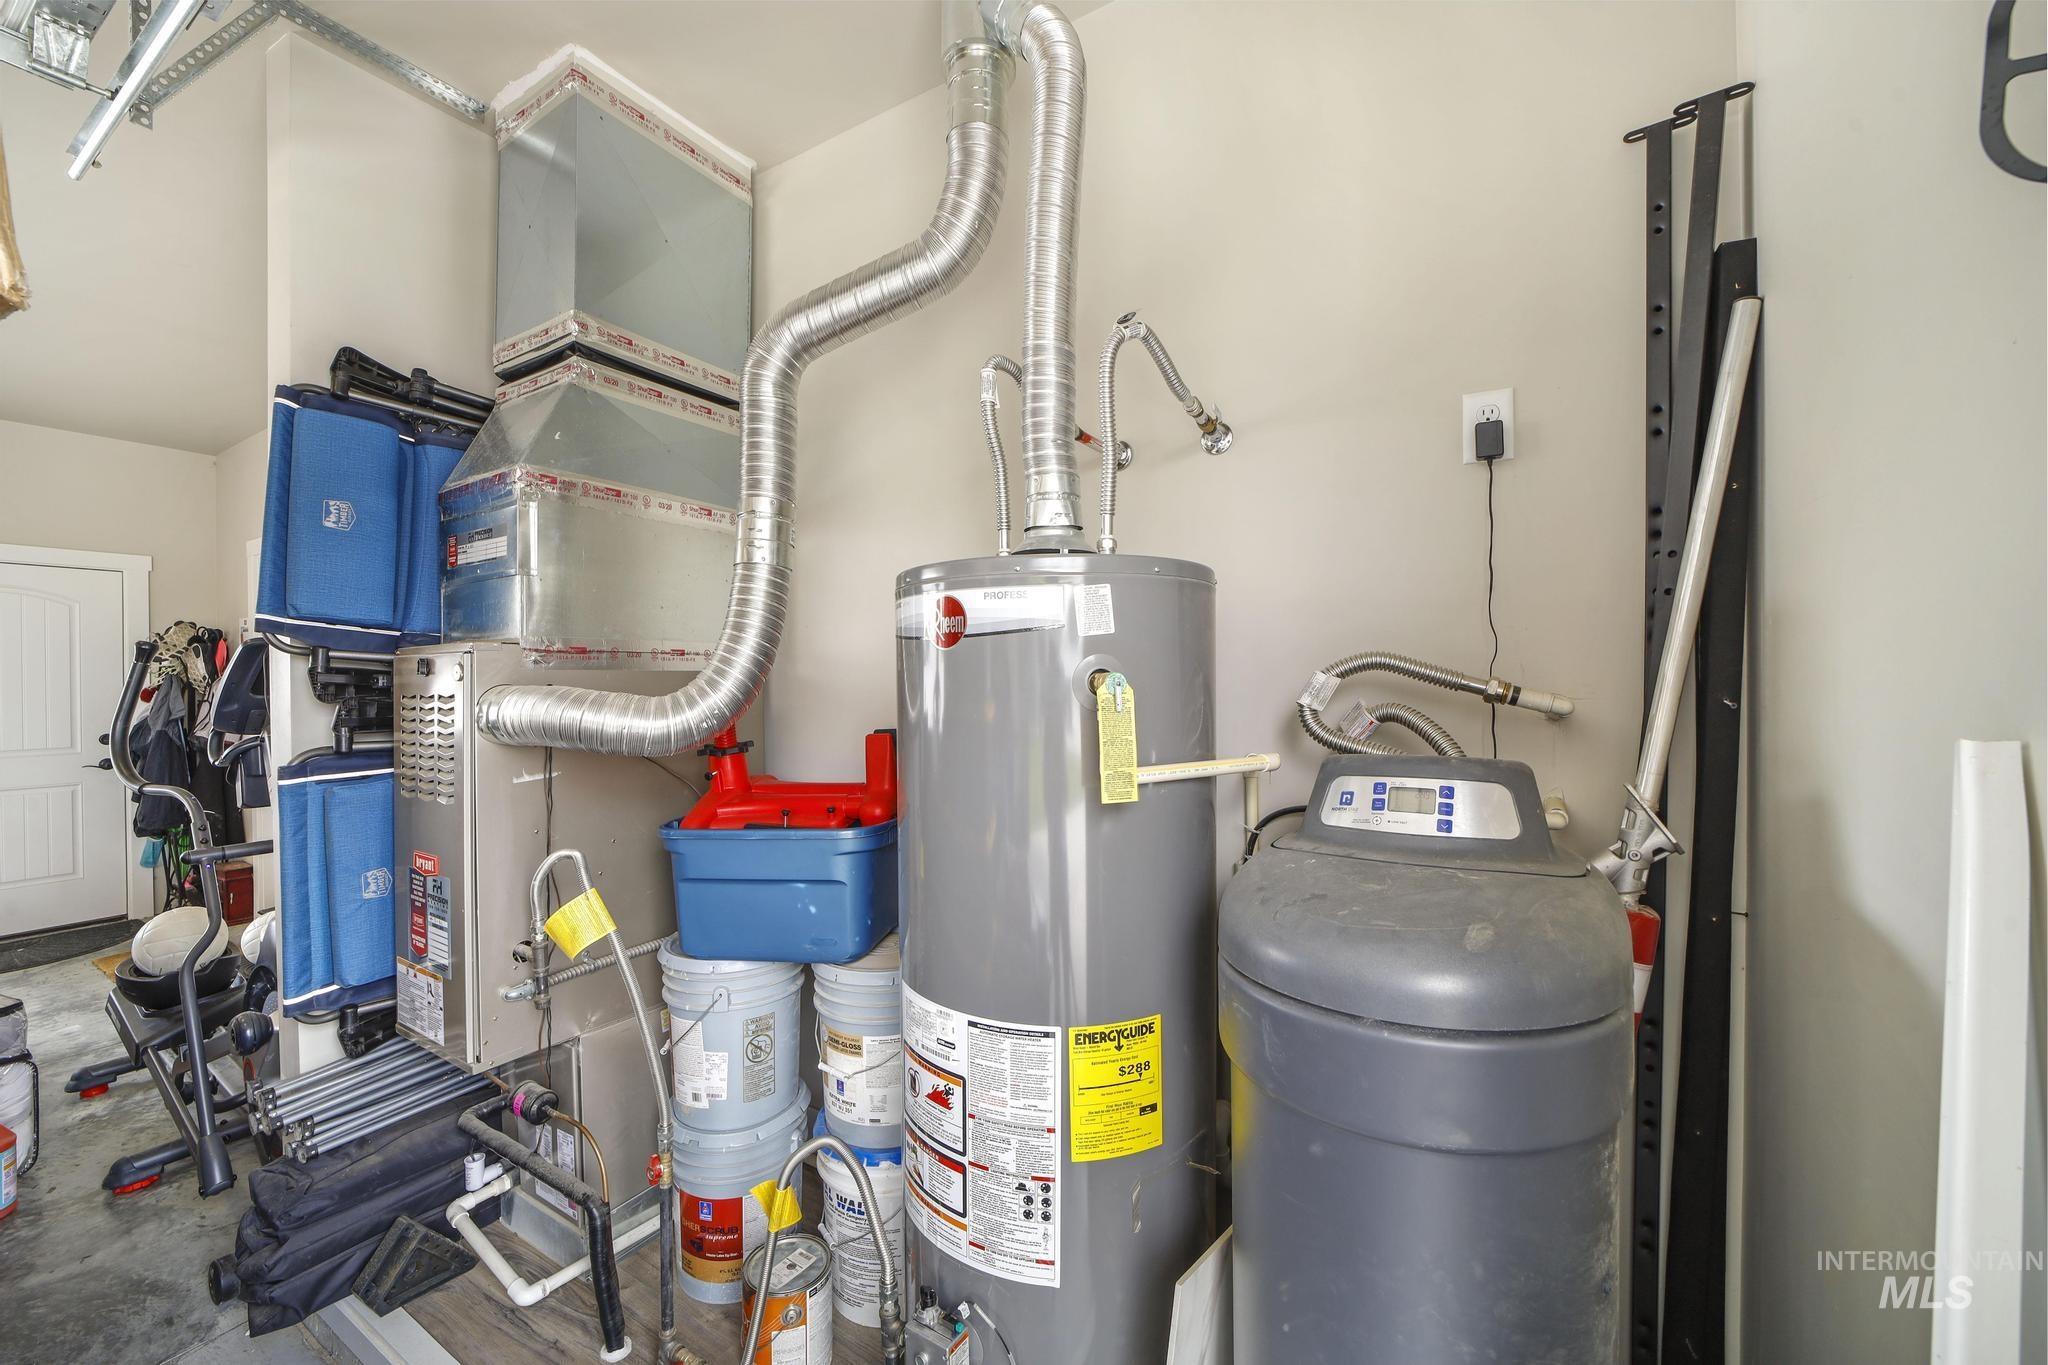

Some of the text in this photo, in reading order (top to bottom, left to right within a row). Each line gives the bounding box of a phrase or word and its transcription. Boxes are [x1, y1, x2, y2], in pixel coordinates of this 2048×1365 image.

[604, 375, 619, 388] 03/20
[593, 485, 622, 498] Shurtape
[658, 501, 673, 511] 03/20
[925, 603, 964, 641] Rheem
[415, 855, 434, 872] bryant
[427, 893, 449, 906] PRECISION
[1075, 1022, 1155, 1049] ENERGYGUIDE
[827, 1035, 862, 1051] SEMI-GLOSS
[1118, 1060, 1151, 1077] $288
[841, 1099, 857, 1108] WHITE
